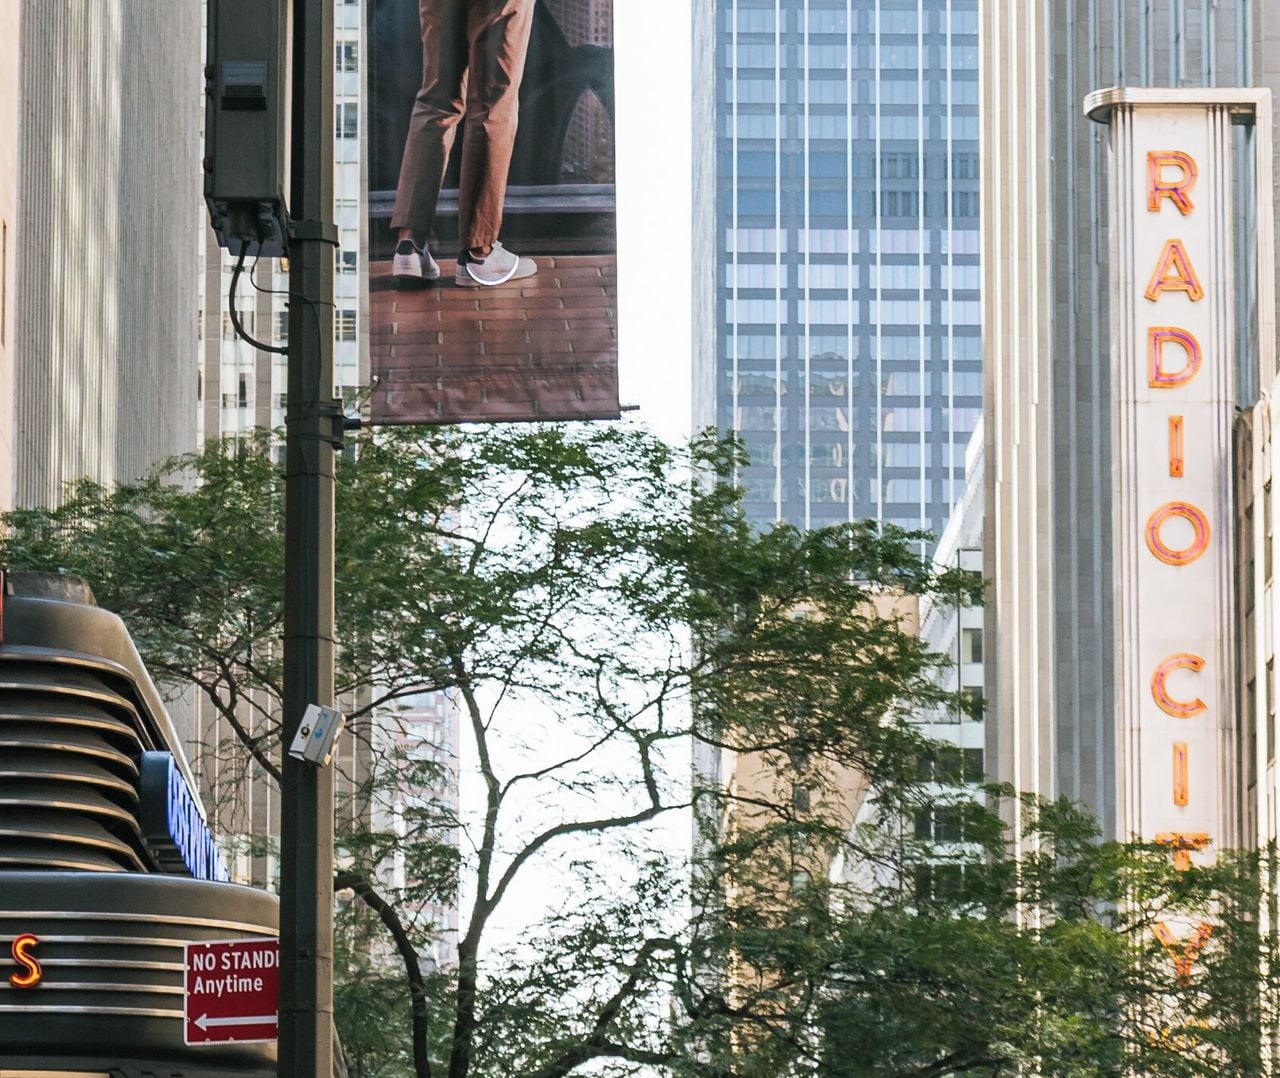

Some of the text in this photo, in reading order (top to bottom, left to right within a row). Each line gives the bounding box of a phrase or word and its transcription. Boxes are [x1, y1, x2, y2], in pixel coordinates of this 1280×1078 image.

[1145, 150, 1213, 985] RADIO CITY
[193, 953, 216, 972] NO
[193, 974, 264, 998] Anytime
